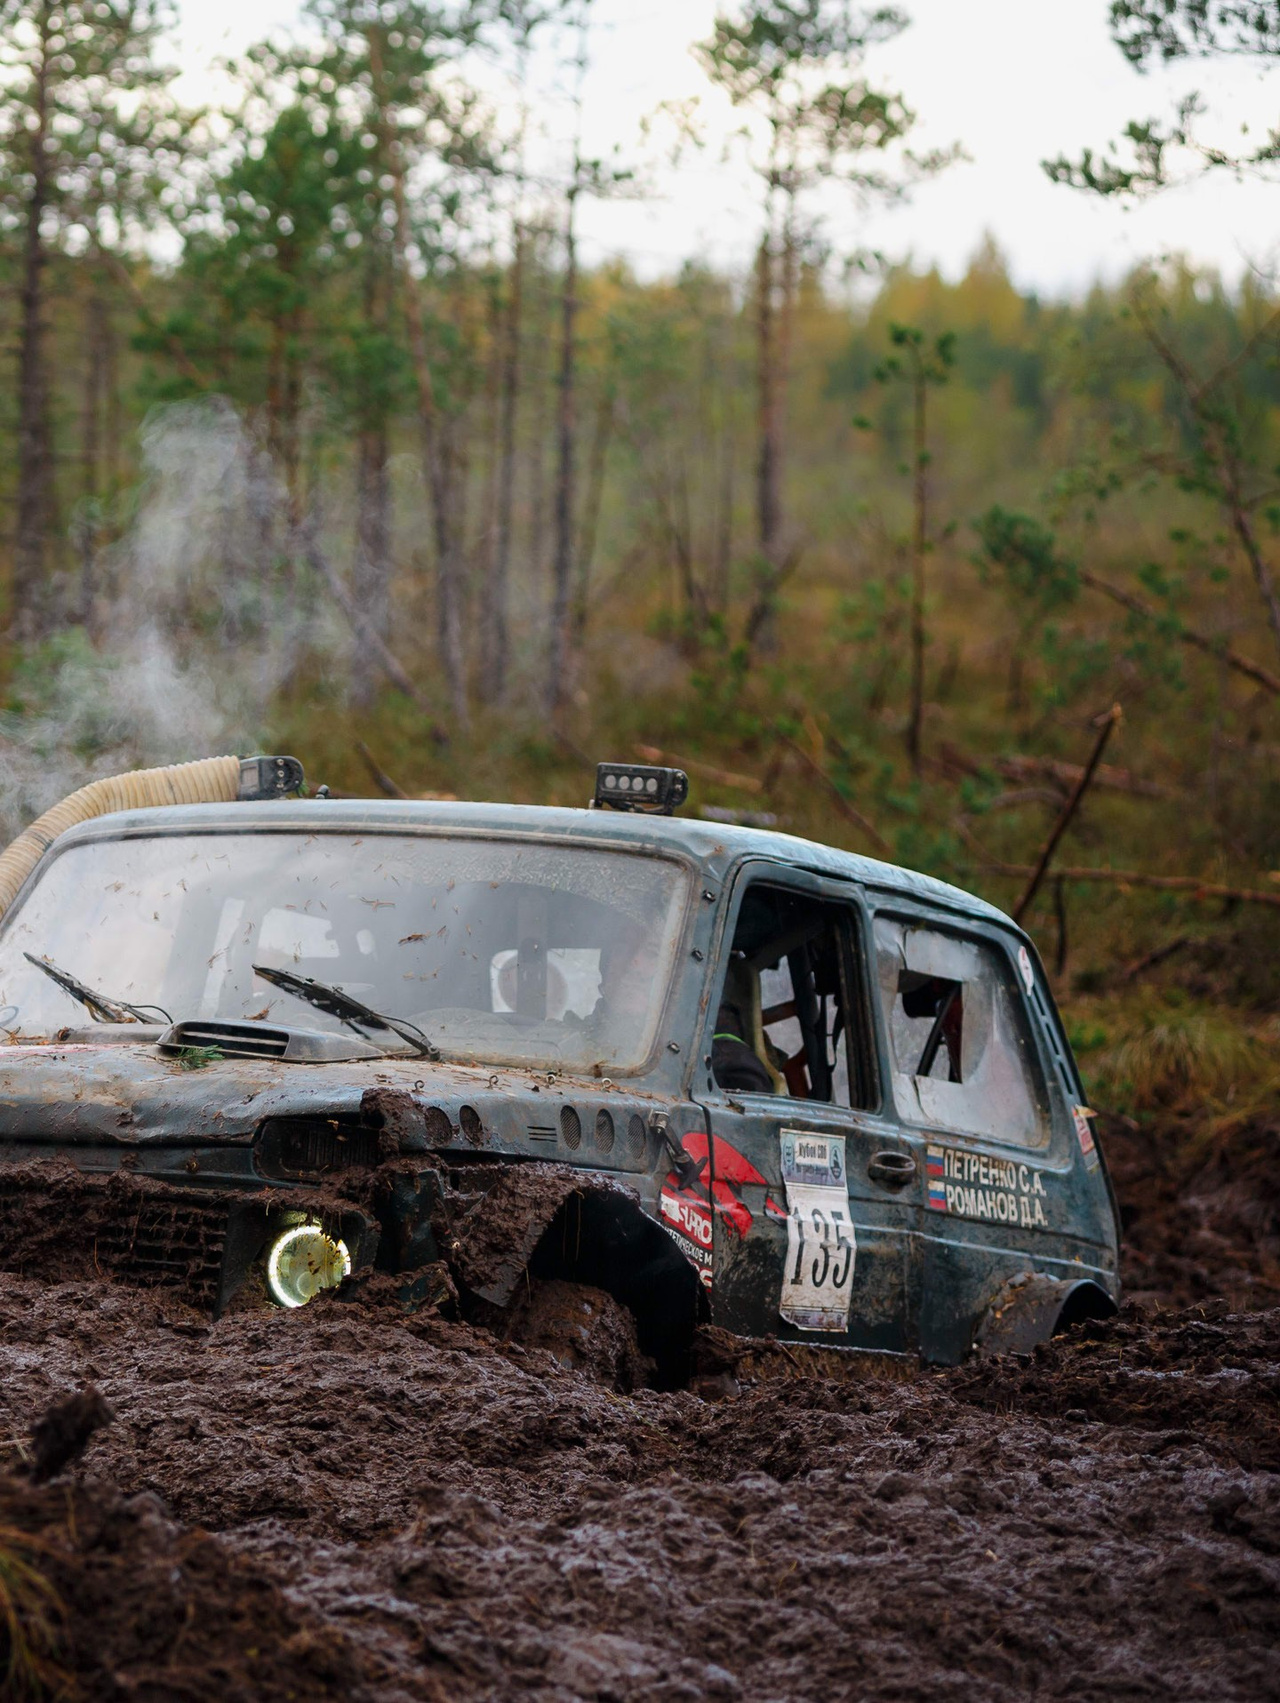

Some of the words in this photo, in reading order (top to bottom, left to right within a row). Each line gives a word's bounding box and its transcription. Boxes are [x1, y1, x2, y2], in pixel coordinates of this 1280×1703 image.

[944, 1149, 1017, 1191] ПЕТРЕНКО
[1019, 1165, 1047, 1197] С.А.
[946, 1184, 1018, 1222] РОМАНОВ
[1020, 1196, 1048, 1229] Д.А.
[790, 1206, 852, 1289] 135
